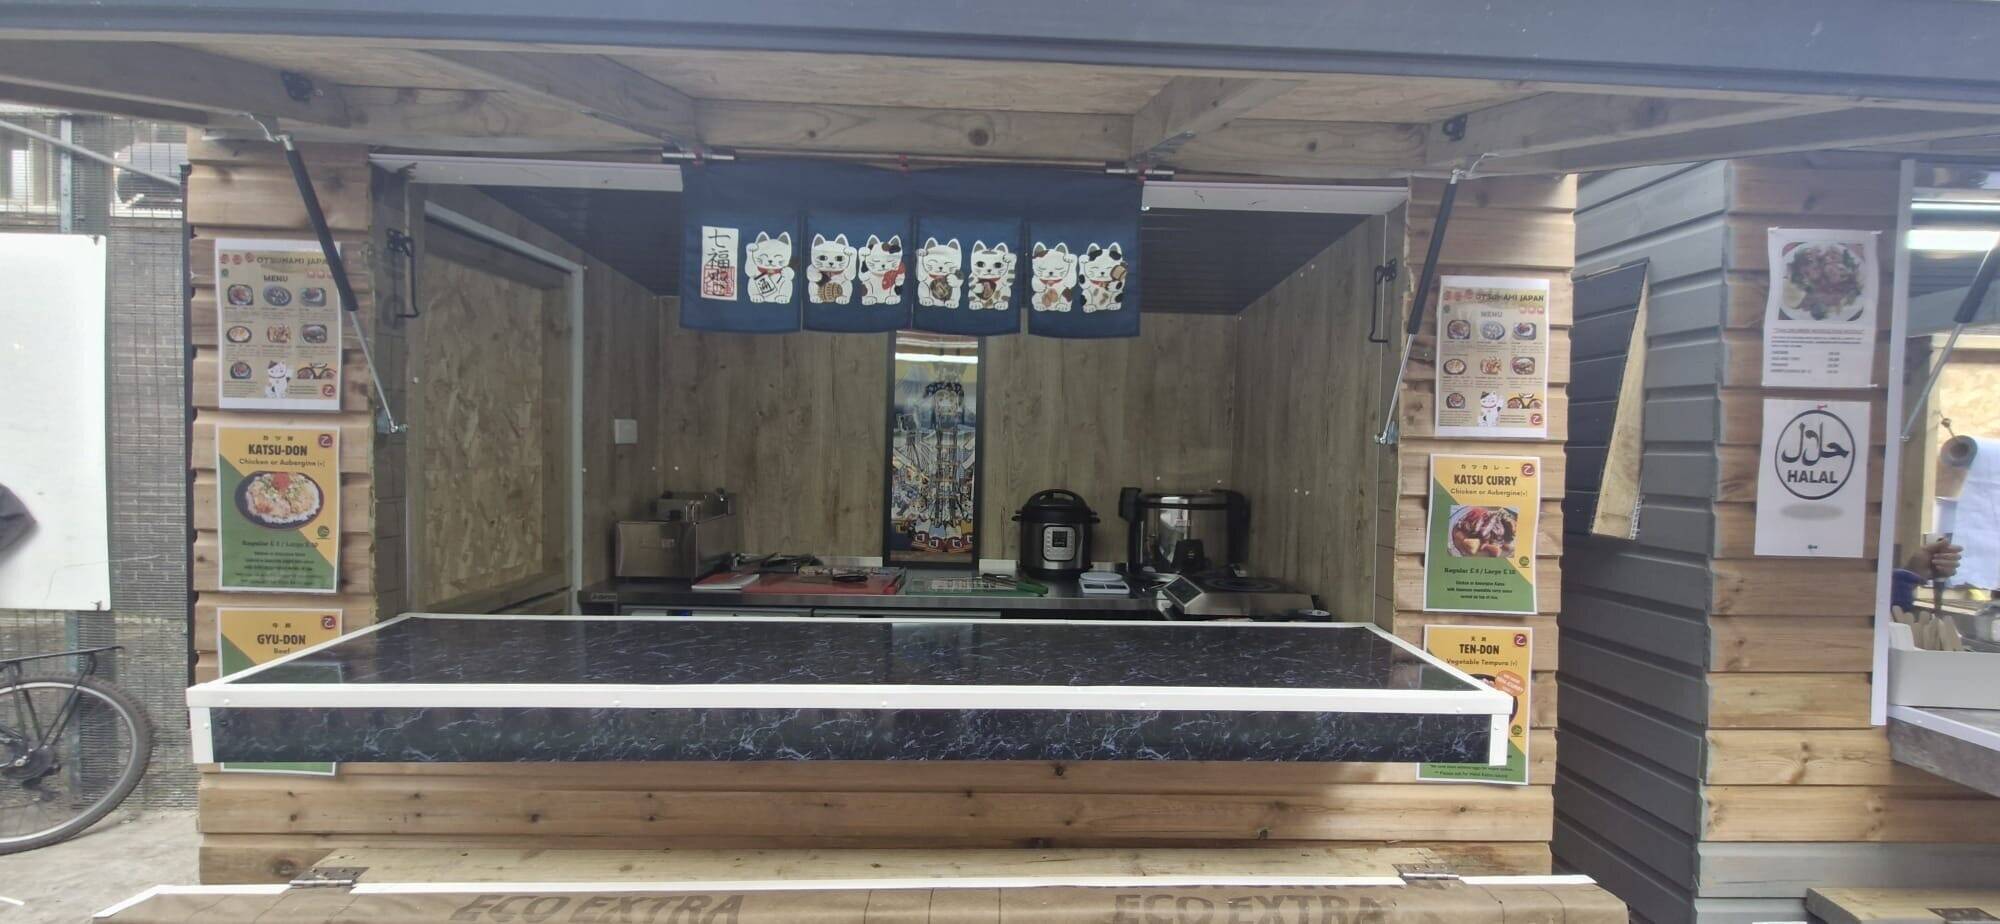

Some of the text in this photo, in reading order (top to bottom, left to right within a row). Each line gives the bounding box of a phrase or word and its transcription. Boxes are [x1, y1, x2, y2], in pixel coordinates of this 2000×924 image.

[264, 274, 289, 282] MENU
[1519, 294, 1544, 303] JAPAN
[248, 444, 308, 456] KATSU-DON
[1781, 422, 1849, 467] حلال
[280, 459, 316, 469] Aubergine
[1454, 474, 1517, 486] KATSU CURRY
[1787, 470, 1838, 484] HALAL
[1444, 567, 1469, 575] Regular
[1484, 568, 1502, 576] Large
[257, 634, 306, 645] GYU-DON
[1459, 643, 1500, 655] TEN-DON
[1446, 658, 1480, 666] Vegetable
[1481, 659, 1509, 667] Tempura
[448, 894, 746, 924] ECO EXTRA
[1112, 893, 1215, 924] ECO
